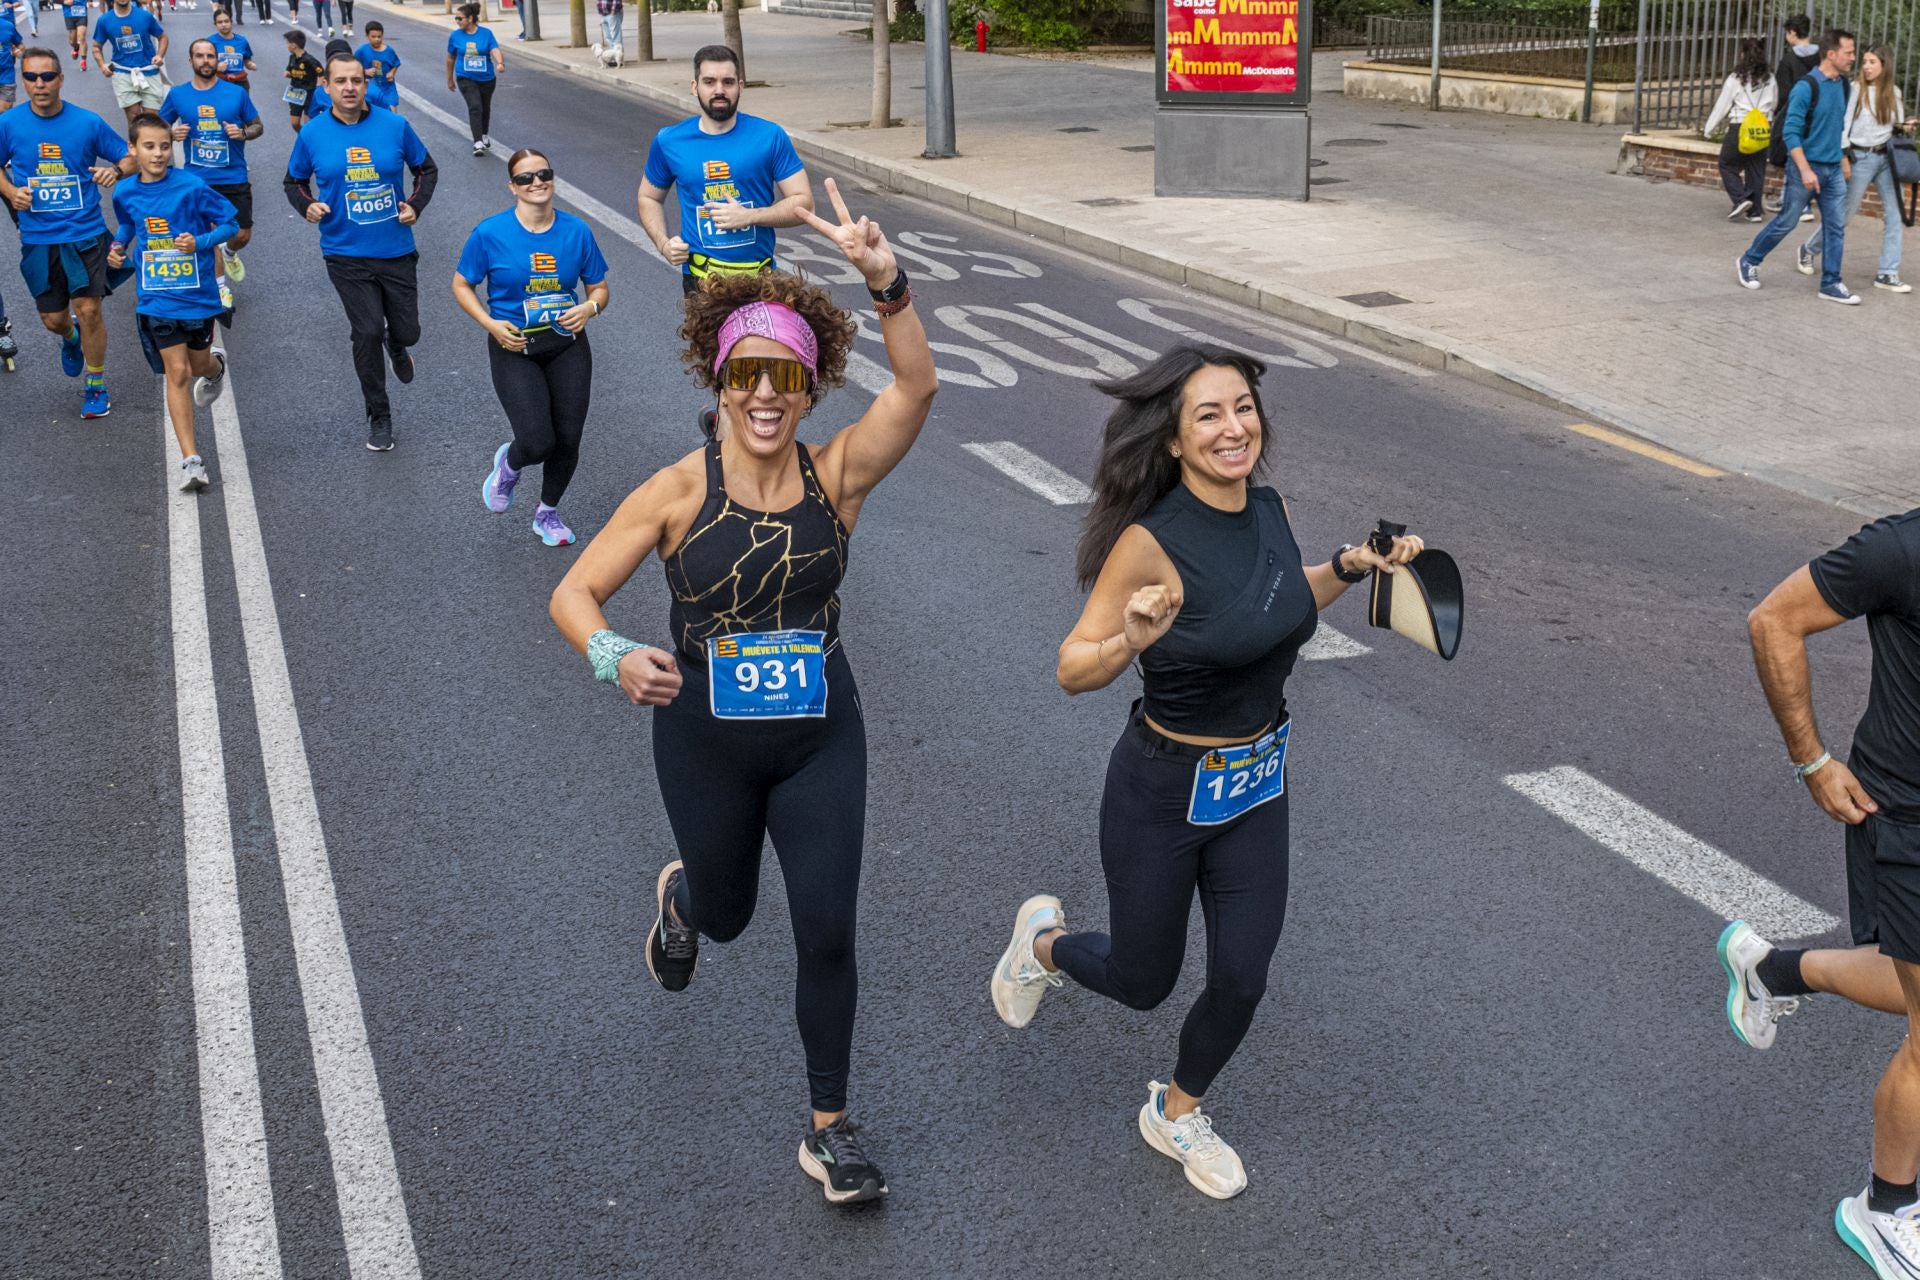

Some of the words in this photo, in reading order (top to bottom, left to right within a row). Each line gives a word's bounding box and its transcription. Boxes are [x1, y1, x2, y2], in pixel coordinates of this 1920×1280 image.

[1242, 66, 1295, 75] McDonald's
[198, 148, 222, 159] 907
[39, 187, 72, 201] 073
[352, 195, 393, 213] 4065
[147, 262, 193, 278] 1439
[538, 309, 567, 323] 47
[735, 658, 808, 692] 931
[764, 693, 789, 701] NINES
[1207, 751, 1280, 801] 1236
